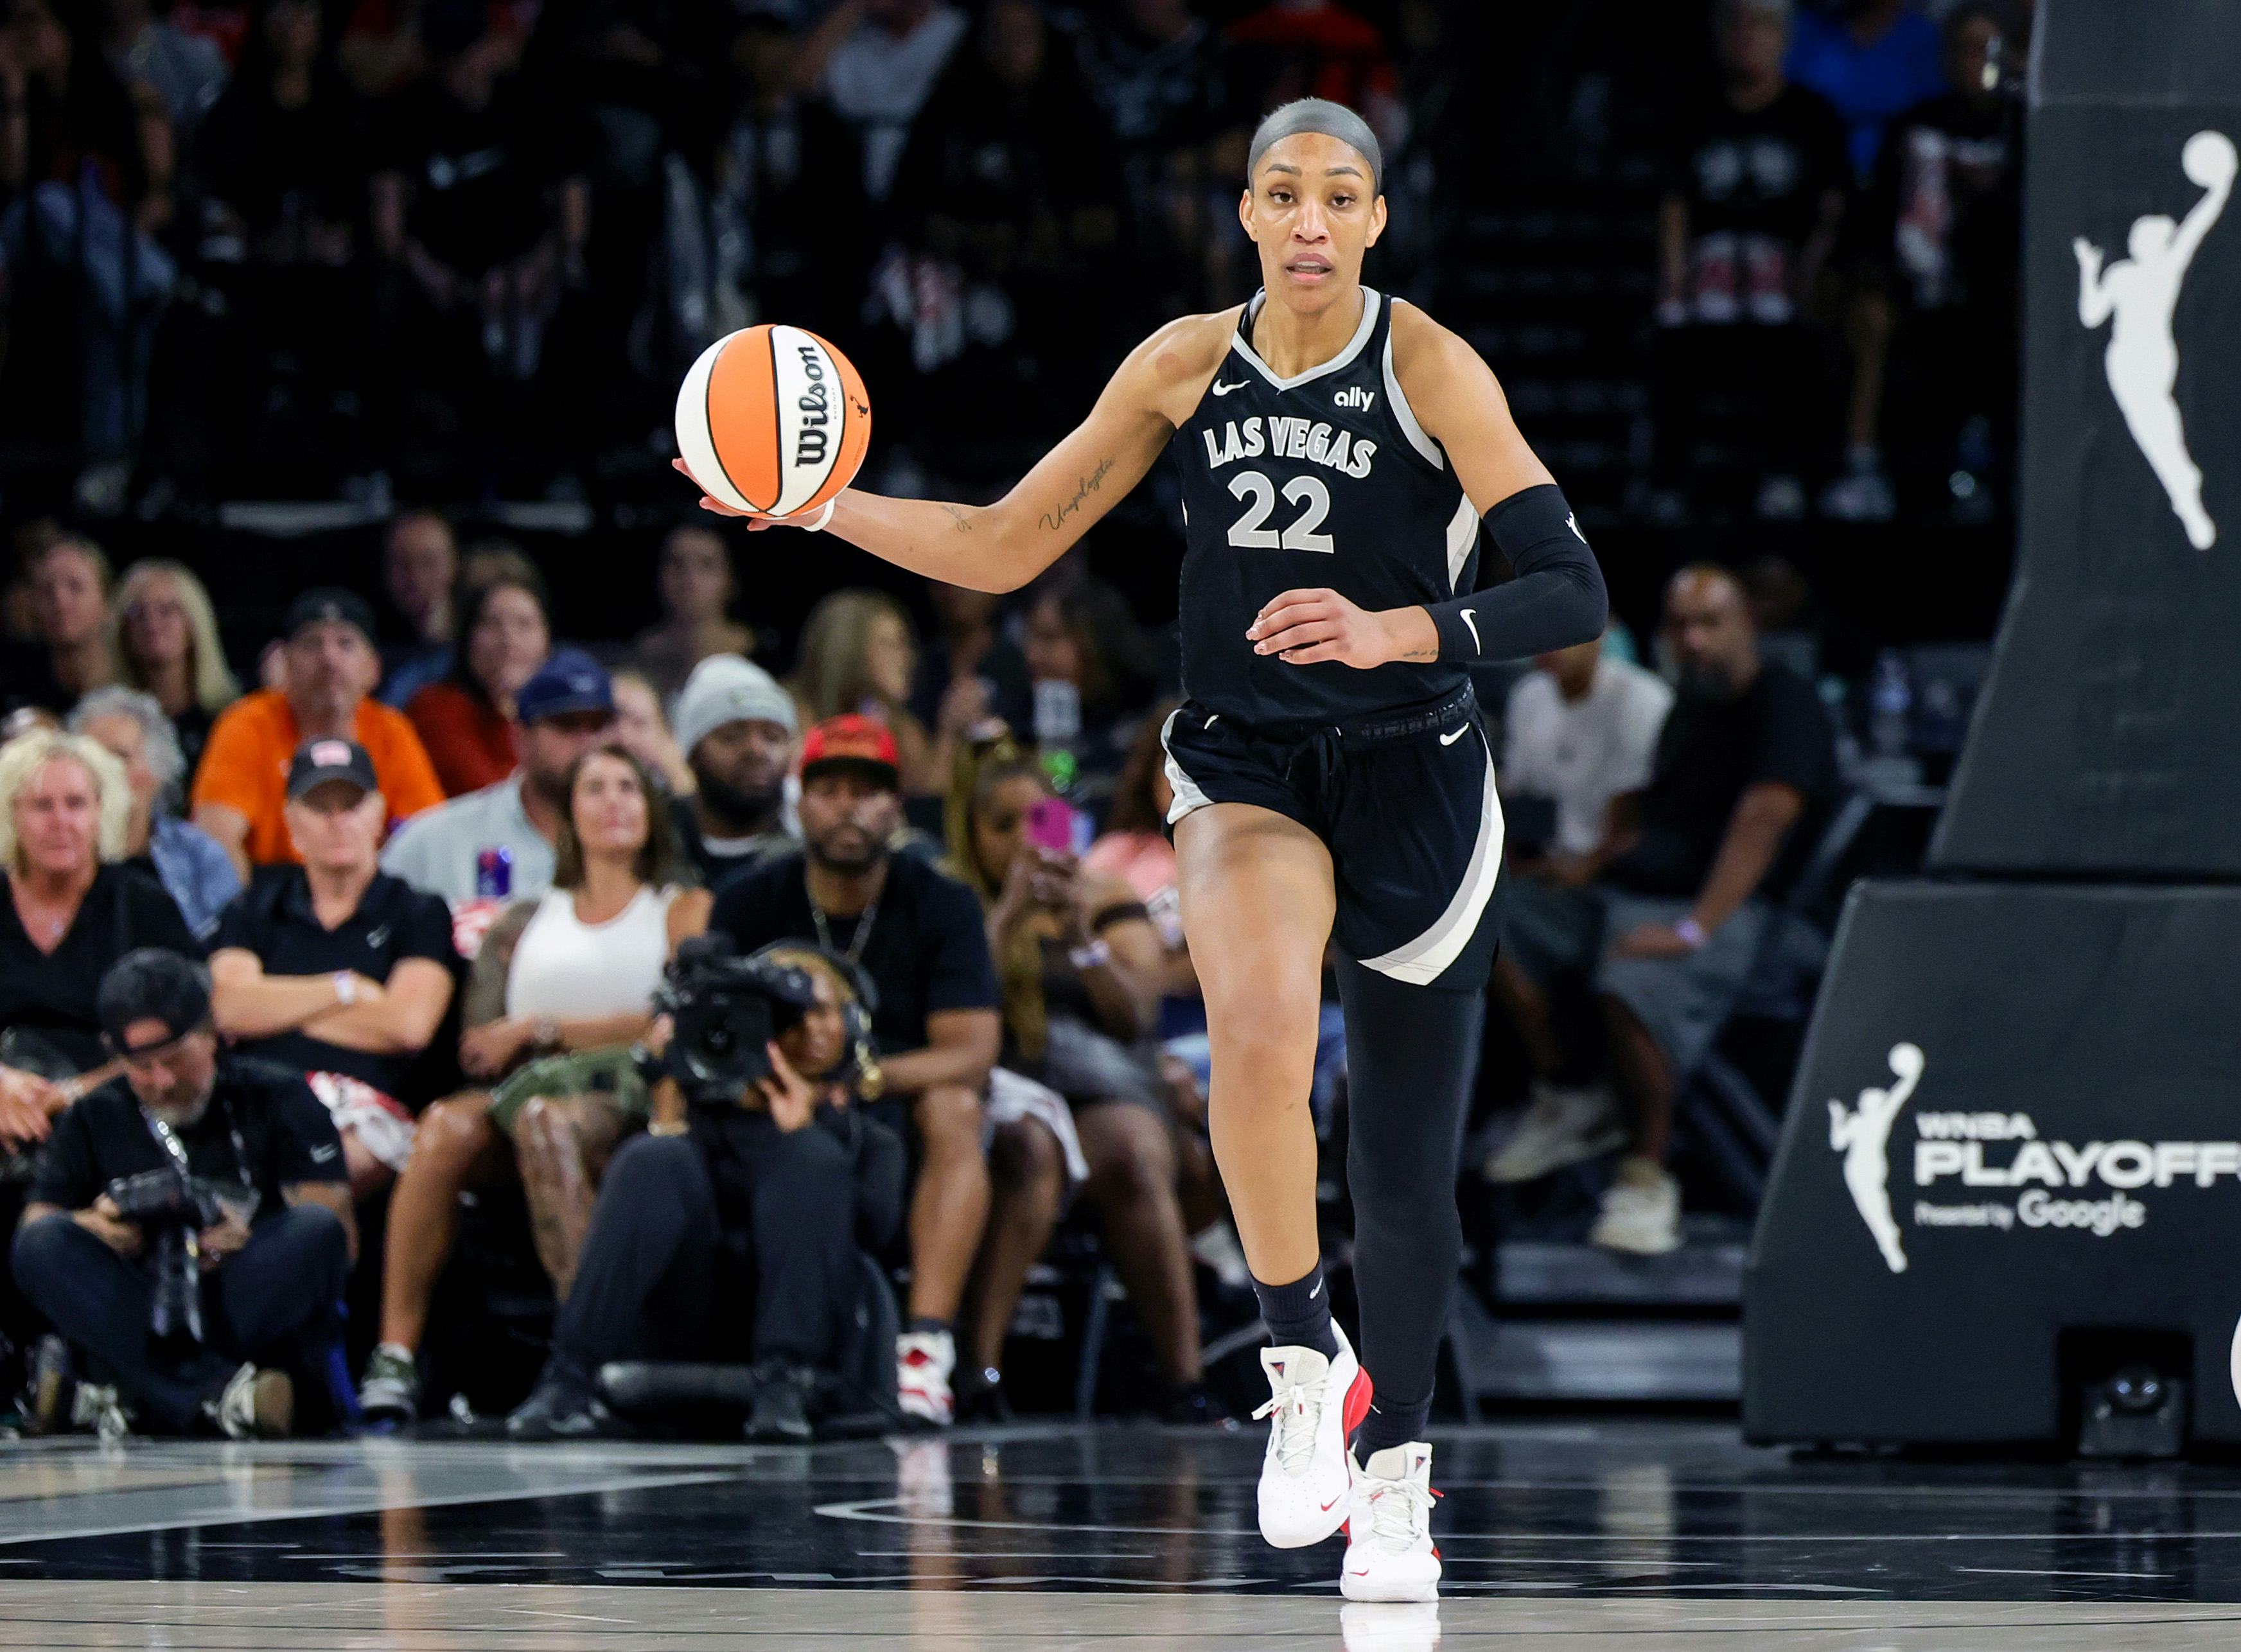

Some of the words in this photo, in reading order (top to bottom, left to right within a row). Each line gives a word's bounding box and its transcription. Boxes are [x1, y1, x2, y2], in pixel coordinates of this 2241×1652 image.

[795, 346, 828, 468] Wilson
[1334, 387, 1375, 412] ally
[1203, 417, 1265, 469] LAS
[1268, 417, 1377, 479] VEGAS
[1227, 471, 1334, 554] 22
[1916, 1112, 2037, 1140] WNBA
[1915, 1140, 2241, 1188] PLAYOFF
[2017, 1188, 2147, 1236] Google
